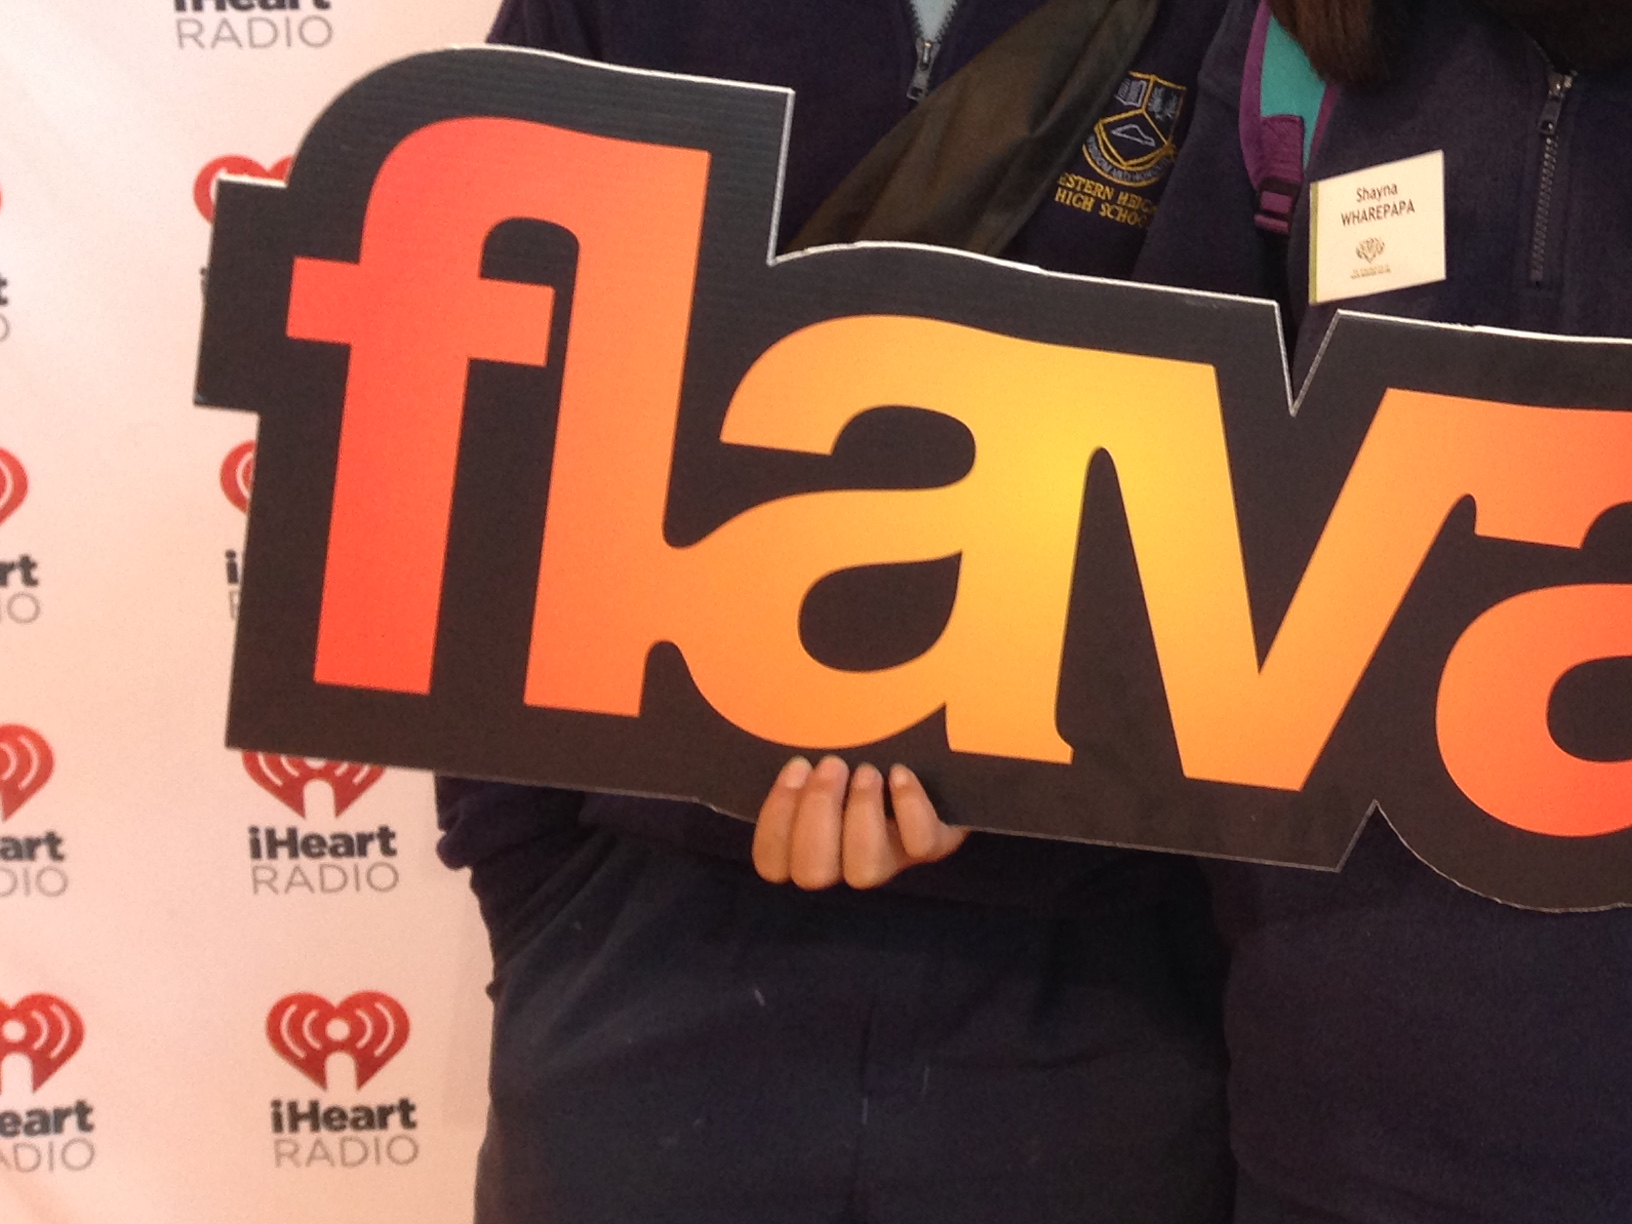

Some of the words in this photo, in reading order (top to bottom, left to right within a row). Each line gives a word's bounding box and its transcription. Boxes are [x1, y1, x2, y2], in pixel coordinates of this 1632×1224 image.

[177, 16, 334, 50] RADIO
[1054, 187, 1096, 213] HIGH
[1057, 172, 1114, 201] ESTERN
[1356, 183, 1398, 203] Shayna
[1341, 199, 1415, 226] WHAREPAPA
[248, 825, 399, 863] iHeart
[253, 863, 400, 896] RADIO
[271, 1097, 419, 1136] iHeart
[0, 1138, 96, 1174] DIO
[275, 1135, 420, 1168] RADIO
